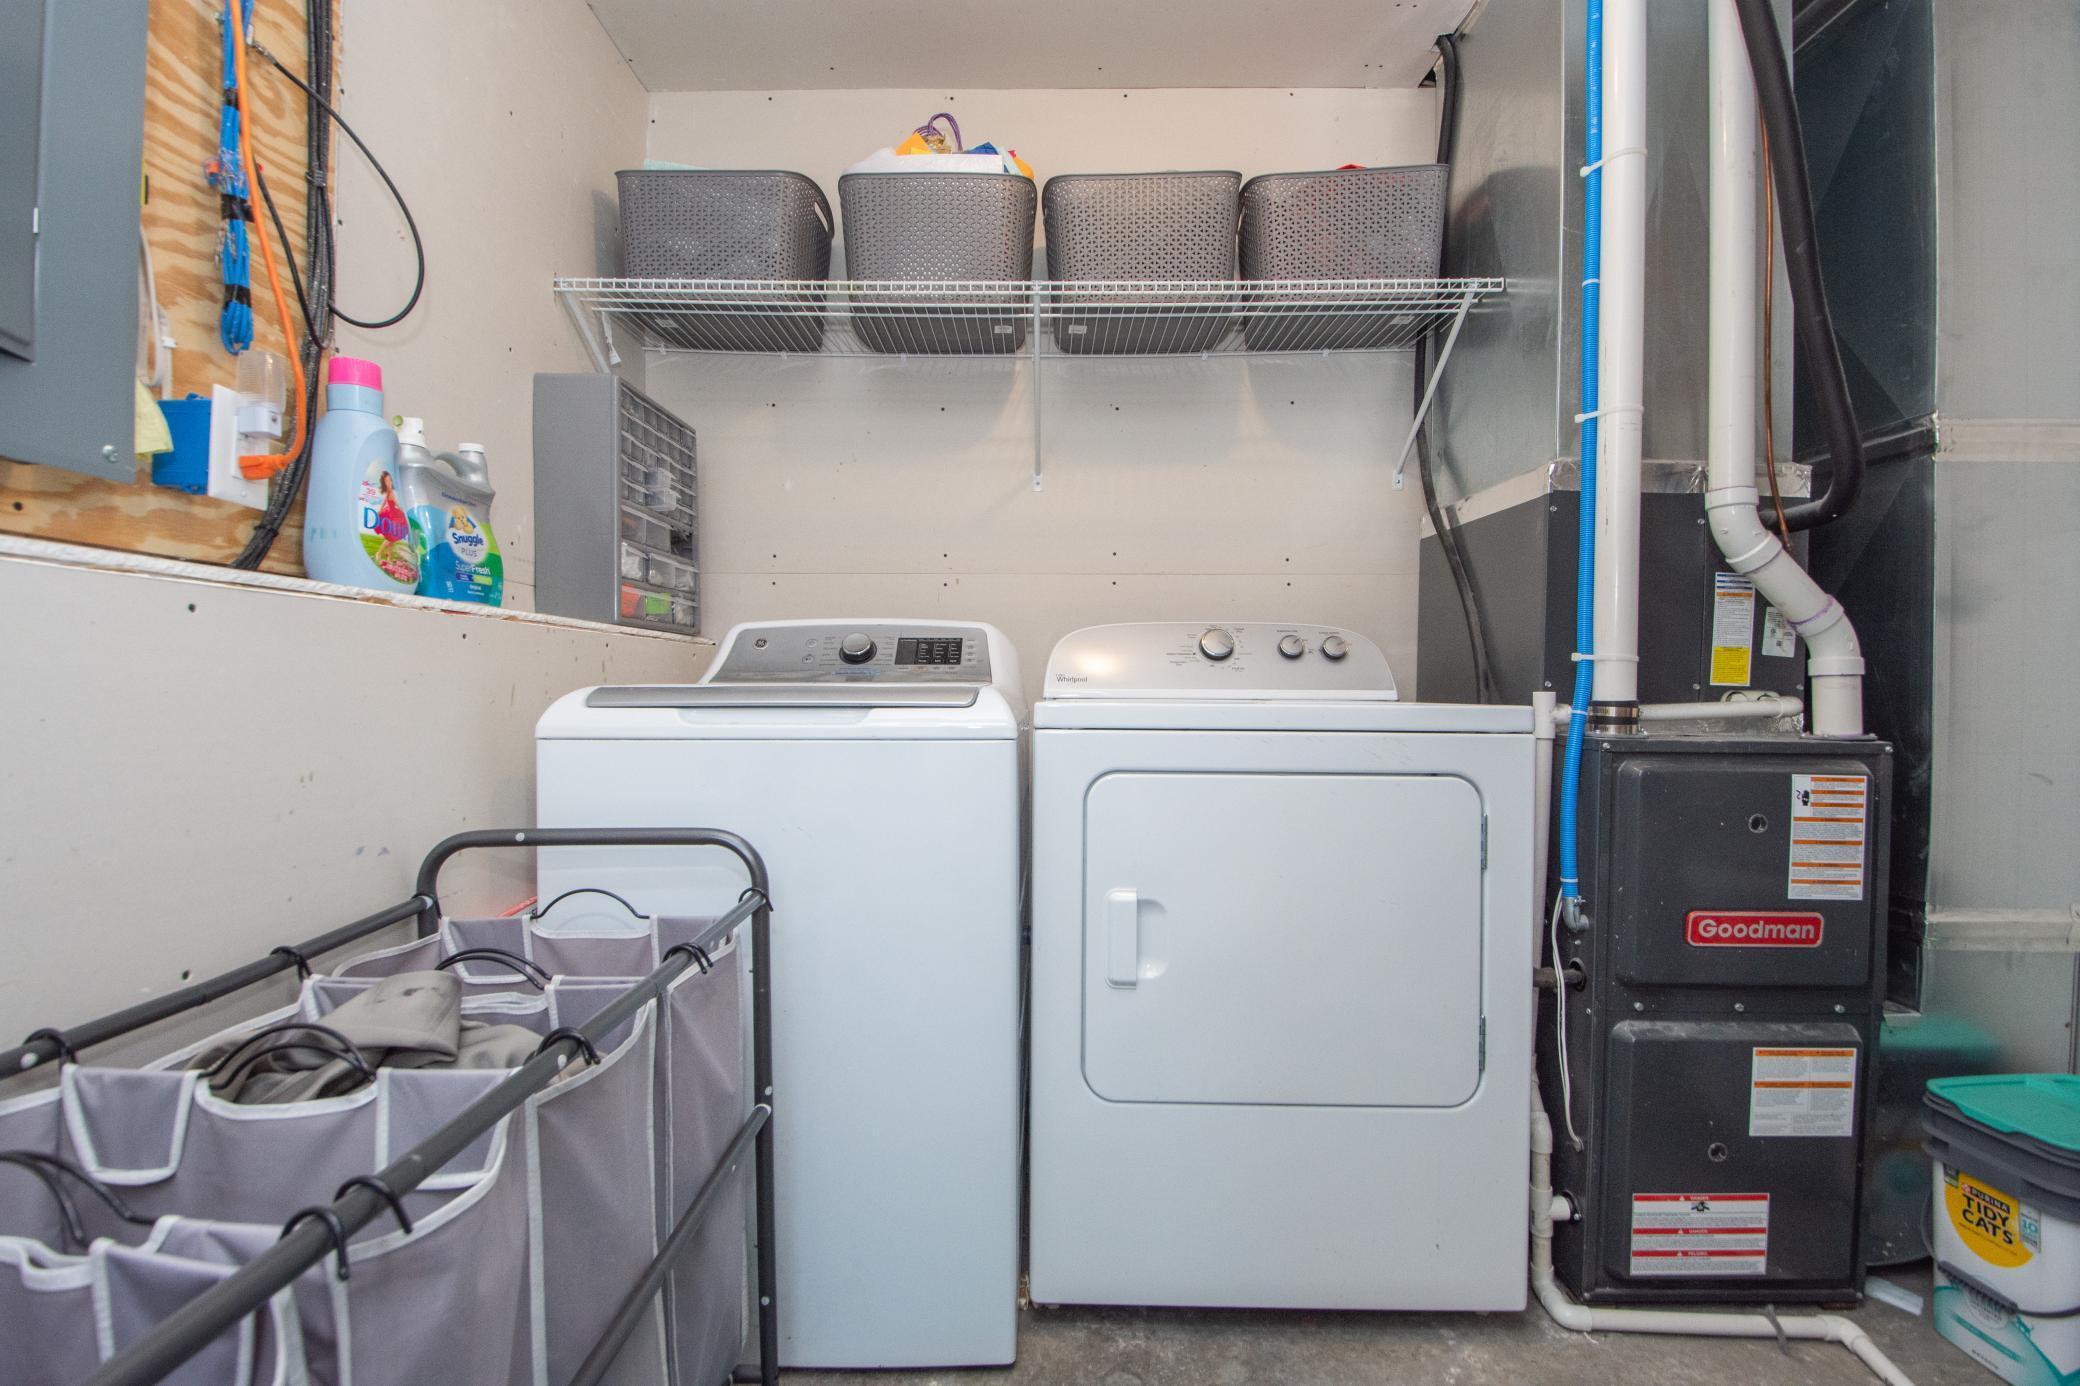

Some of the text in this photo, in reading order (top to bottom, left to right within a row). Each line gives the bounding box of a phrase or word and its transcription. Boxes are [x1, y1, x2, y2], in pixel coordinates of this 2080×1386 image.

[452, 533, 484, 547] Snuggle
[461, 547, 478, 557] PLUS
[1056, 676, 1088, 684] Whirlpool
[1698, 919, 1815, 939] Goodman
[1971, 1187, 2009, 1211] PURINA
[1962, 1193, 2010, 1228] TIDY
[1962, 1209, 2014, 1245] CATS
